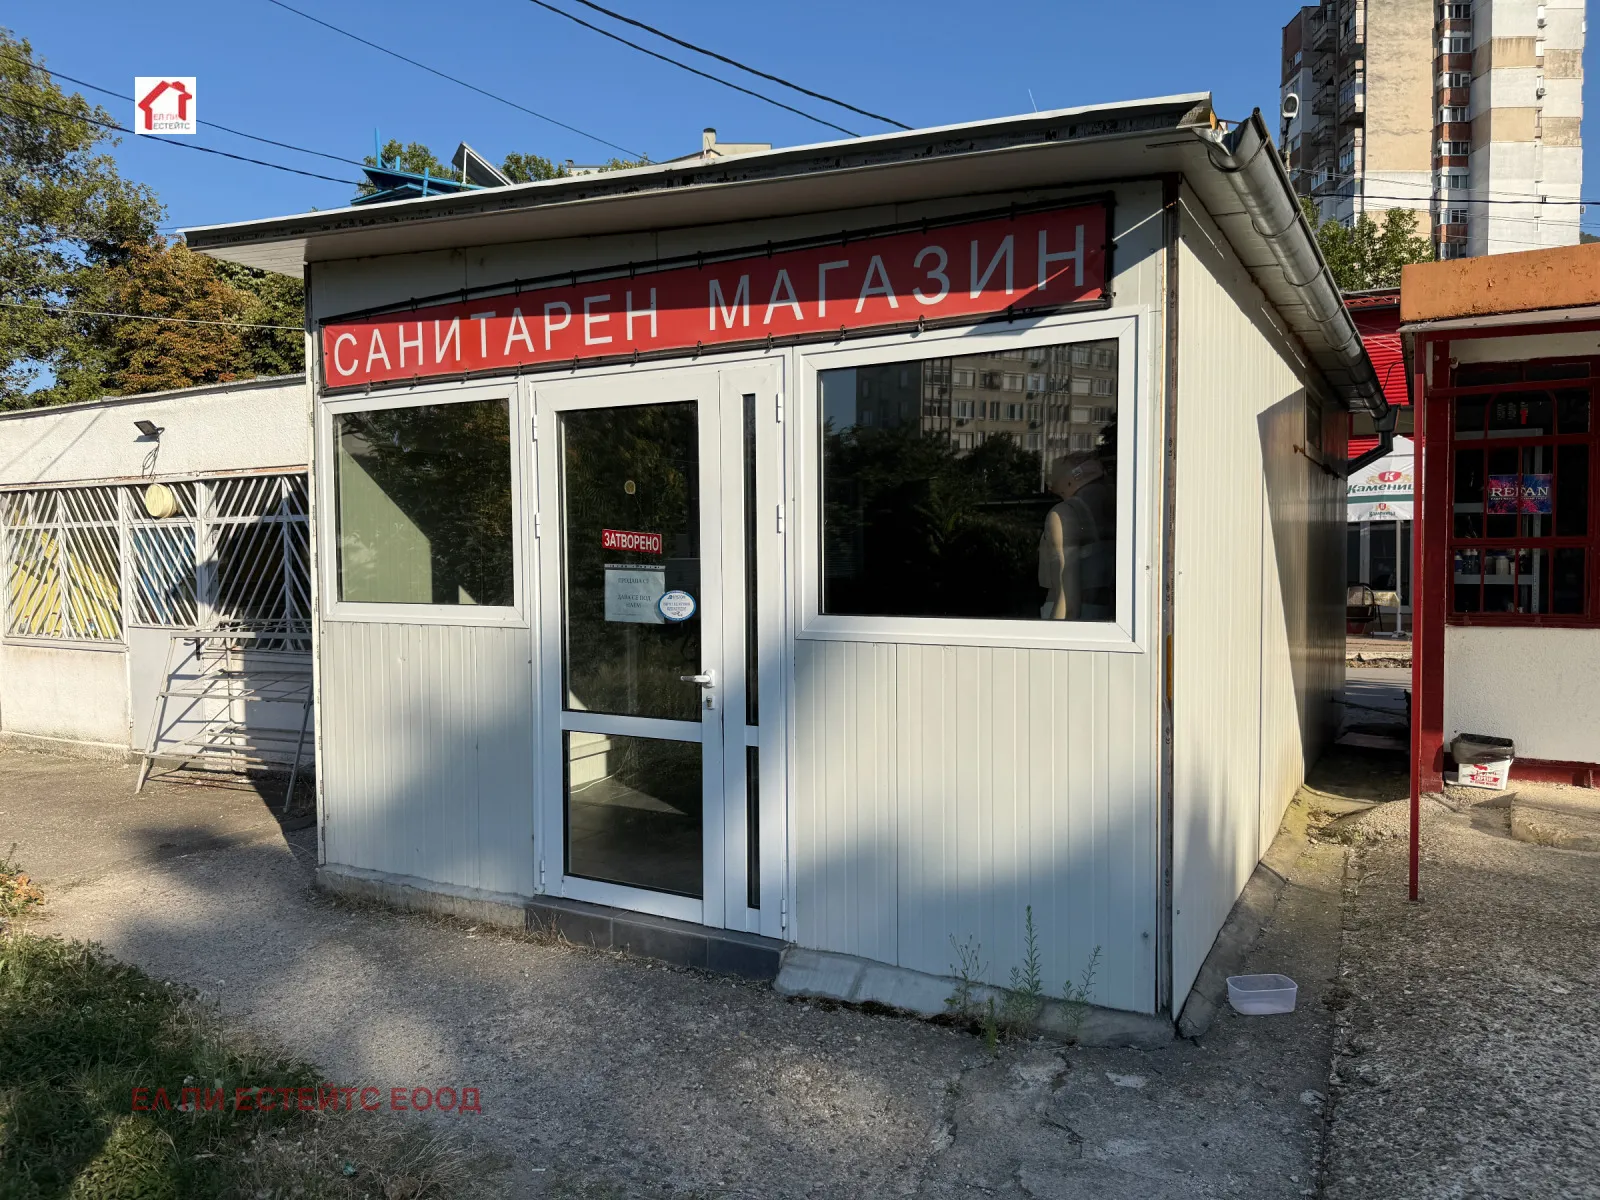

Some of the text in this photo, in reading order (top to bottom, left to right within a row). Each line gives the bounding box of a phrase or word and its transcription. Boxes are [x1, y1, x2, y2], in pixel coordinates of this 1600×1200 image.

[333, 224, 1085, 377] САНИТАРЕН МАГАЗИН
[604, 532, 659, 551] ЗАТВОРЕНО
